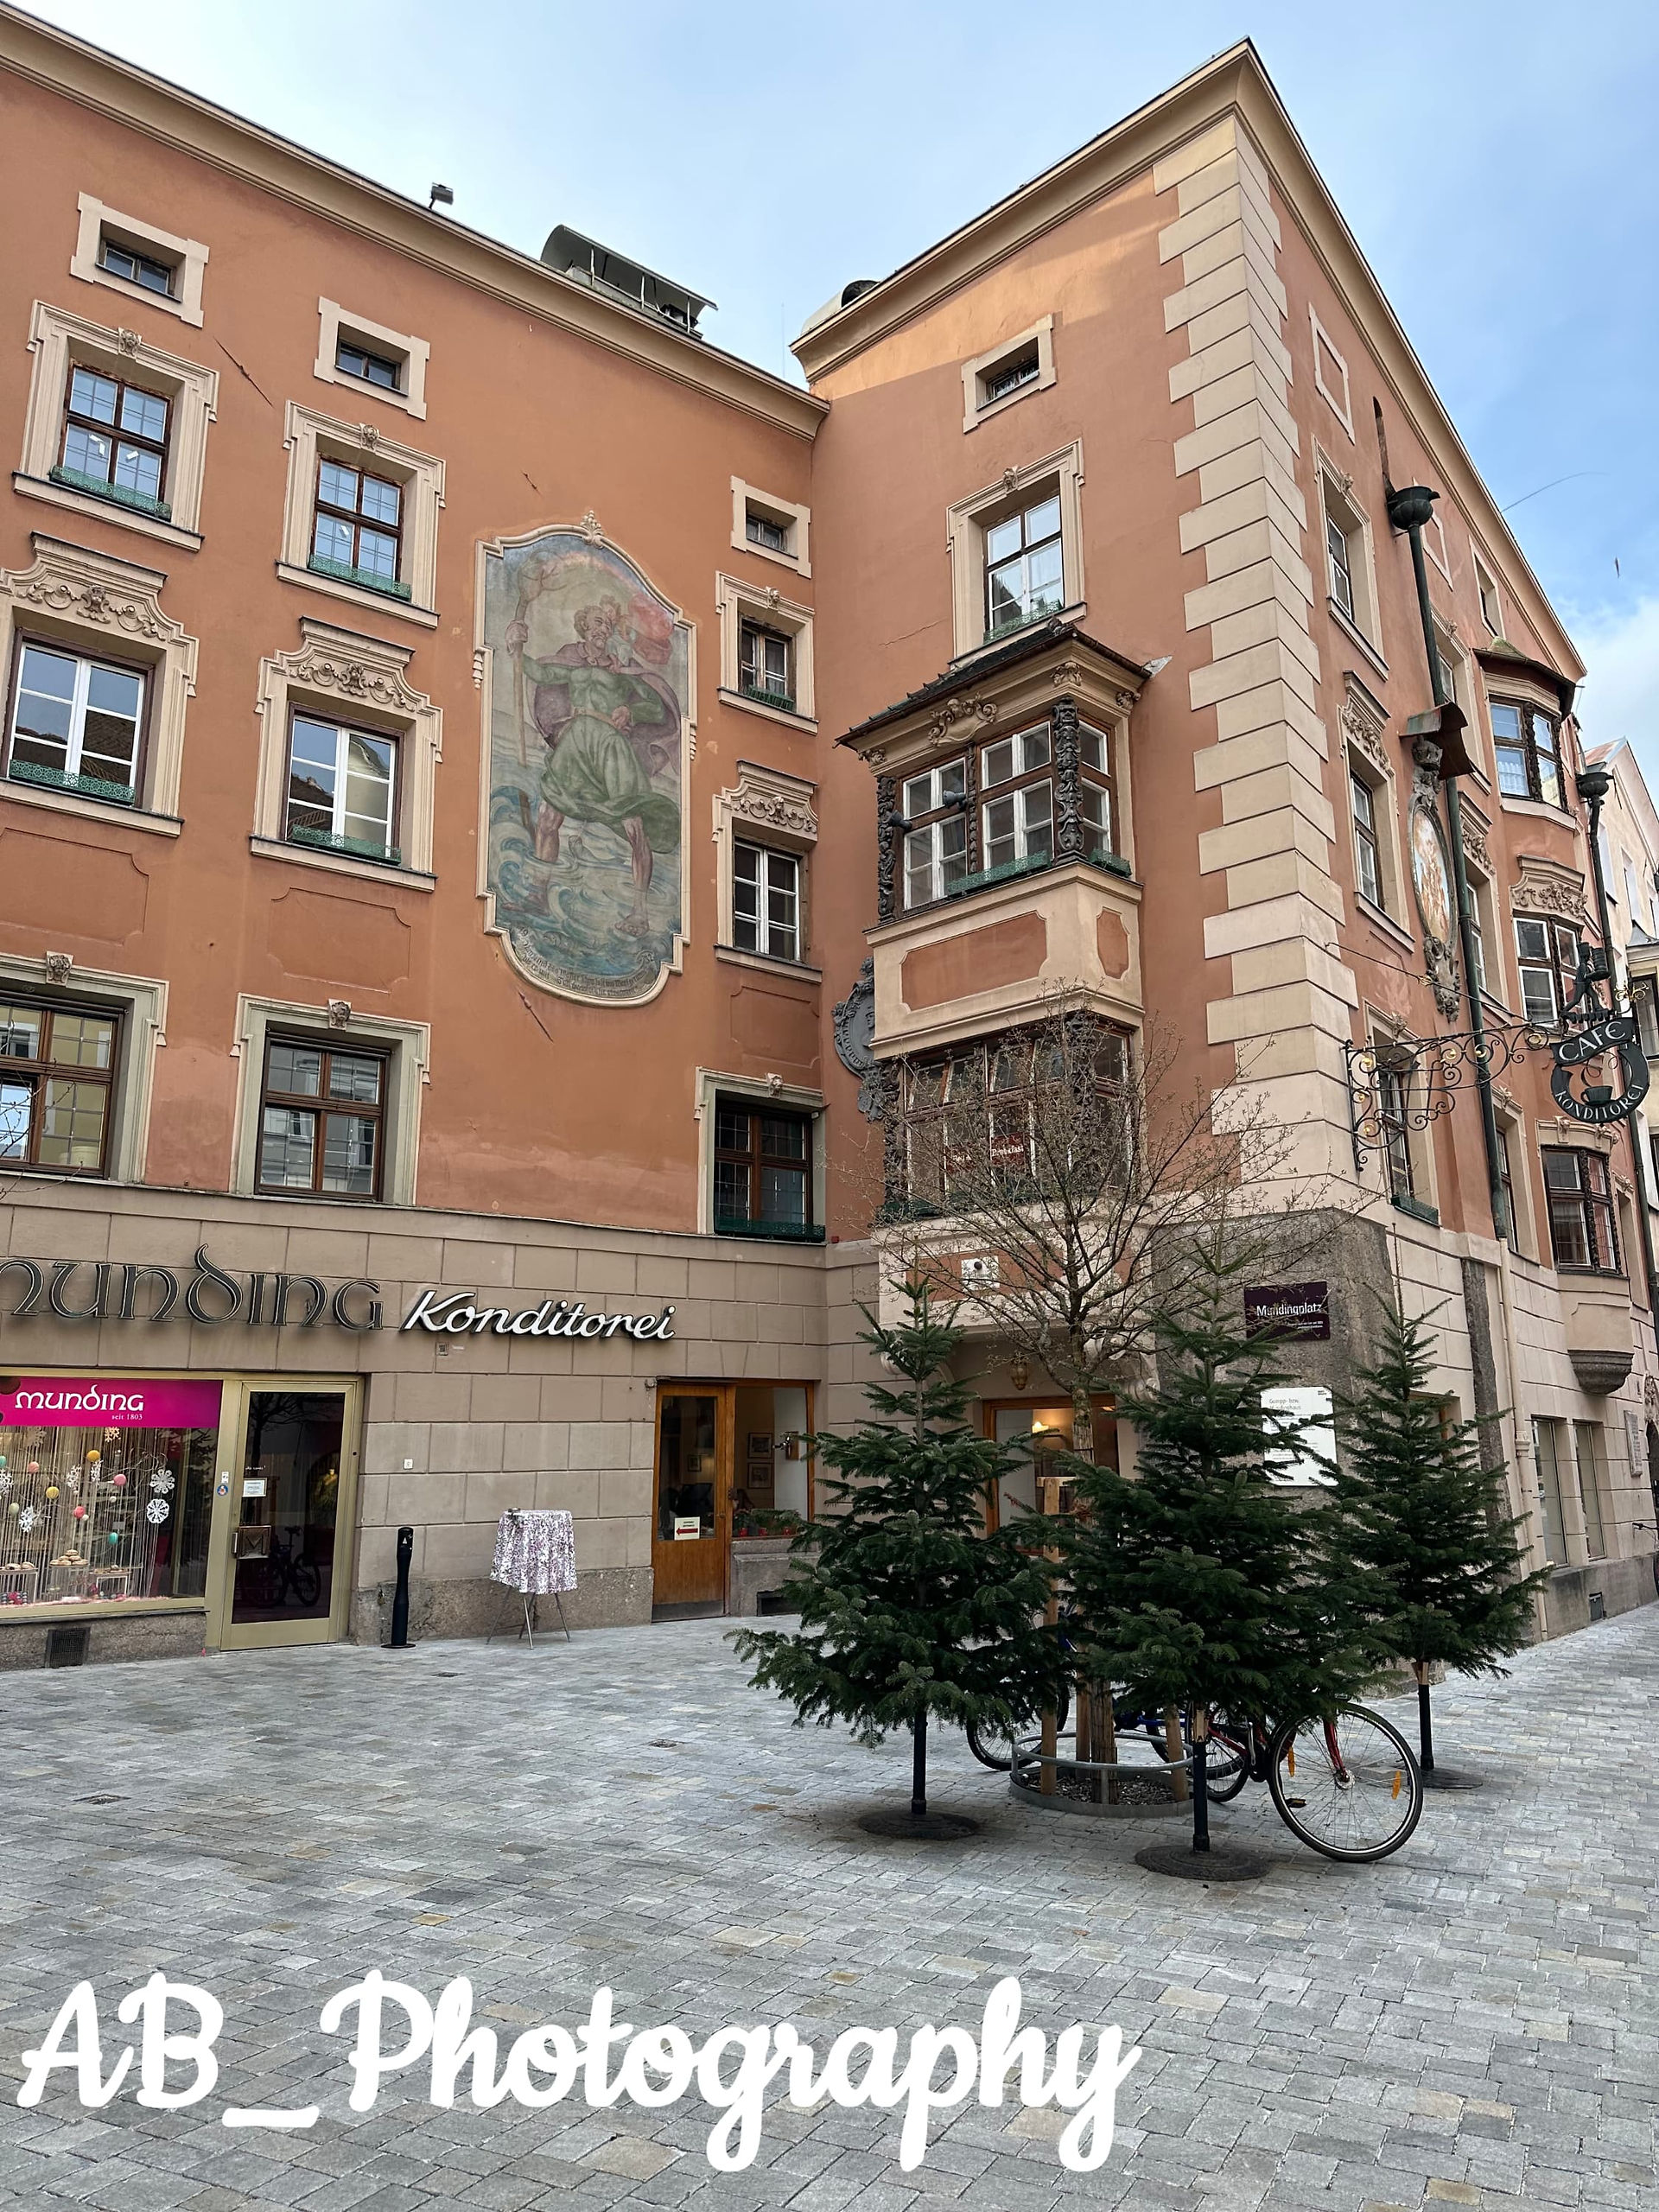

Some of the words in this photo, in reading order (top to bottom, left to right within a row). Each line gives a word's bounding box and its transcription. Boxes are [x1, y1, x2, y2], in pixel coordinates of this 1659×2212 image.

[1558, 1020, 1626, 1062] CAFE
[1554, 1084, 1644, 1120] KONDITOREI
[399, 1290, 677, 1340] Konditorei
[1256, 1302, 1322, 1317] Mundingplatz
